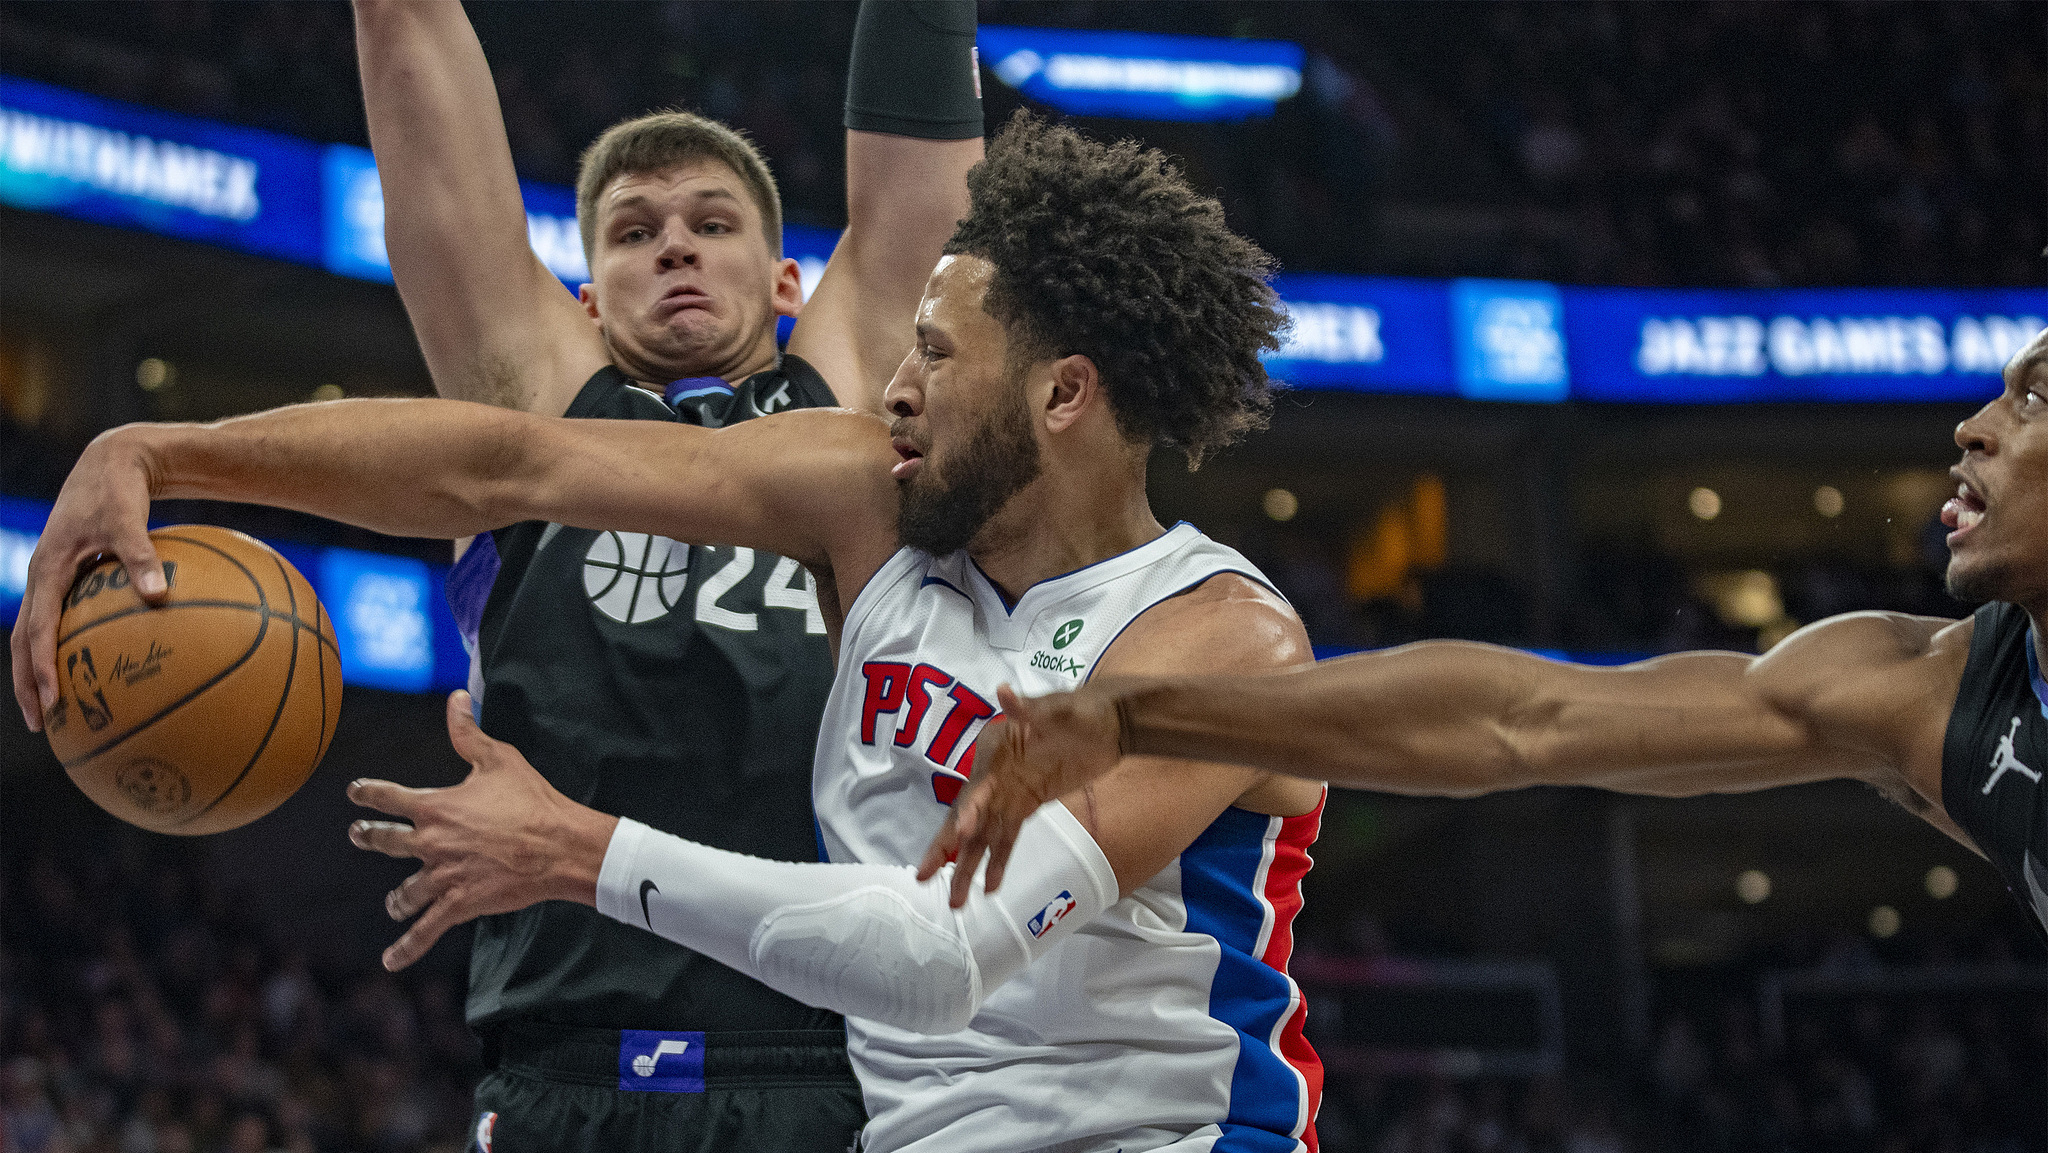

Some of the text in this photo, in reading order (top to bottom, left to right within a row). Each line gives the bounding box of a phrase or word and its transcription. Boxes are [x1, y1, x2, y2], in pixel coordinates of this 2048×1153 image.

[1767, 314, 1950, 376] GAMES
[695, 545, 828, 636] 24
[1030, 650, 1086, 678] StockX
